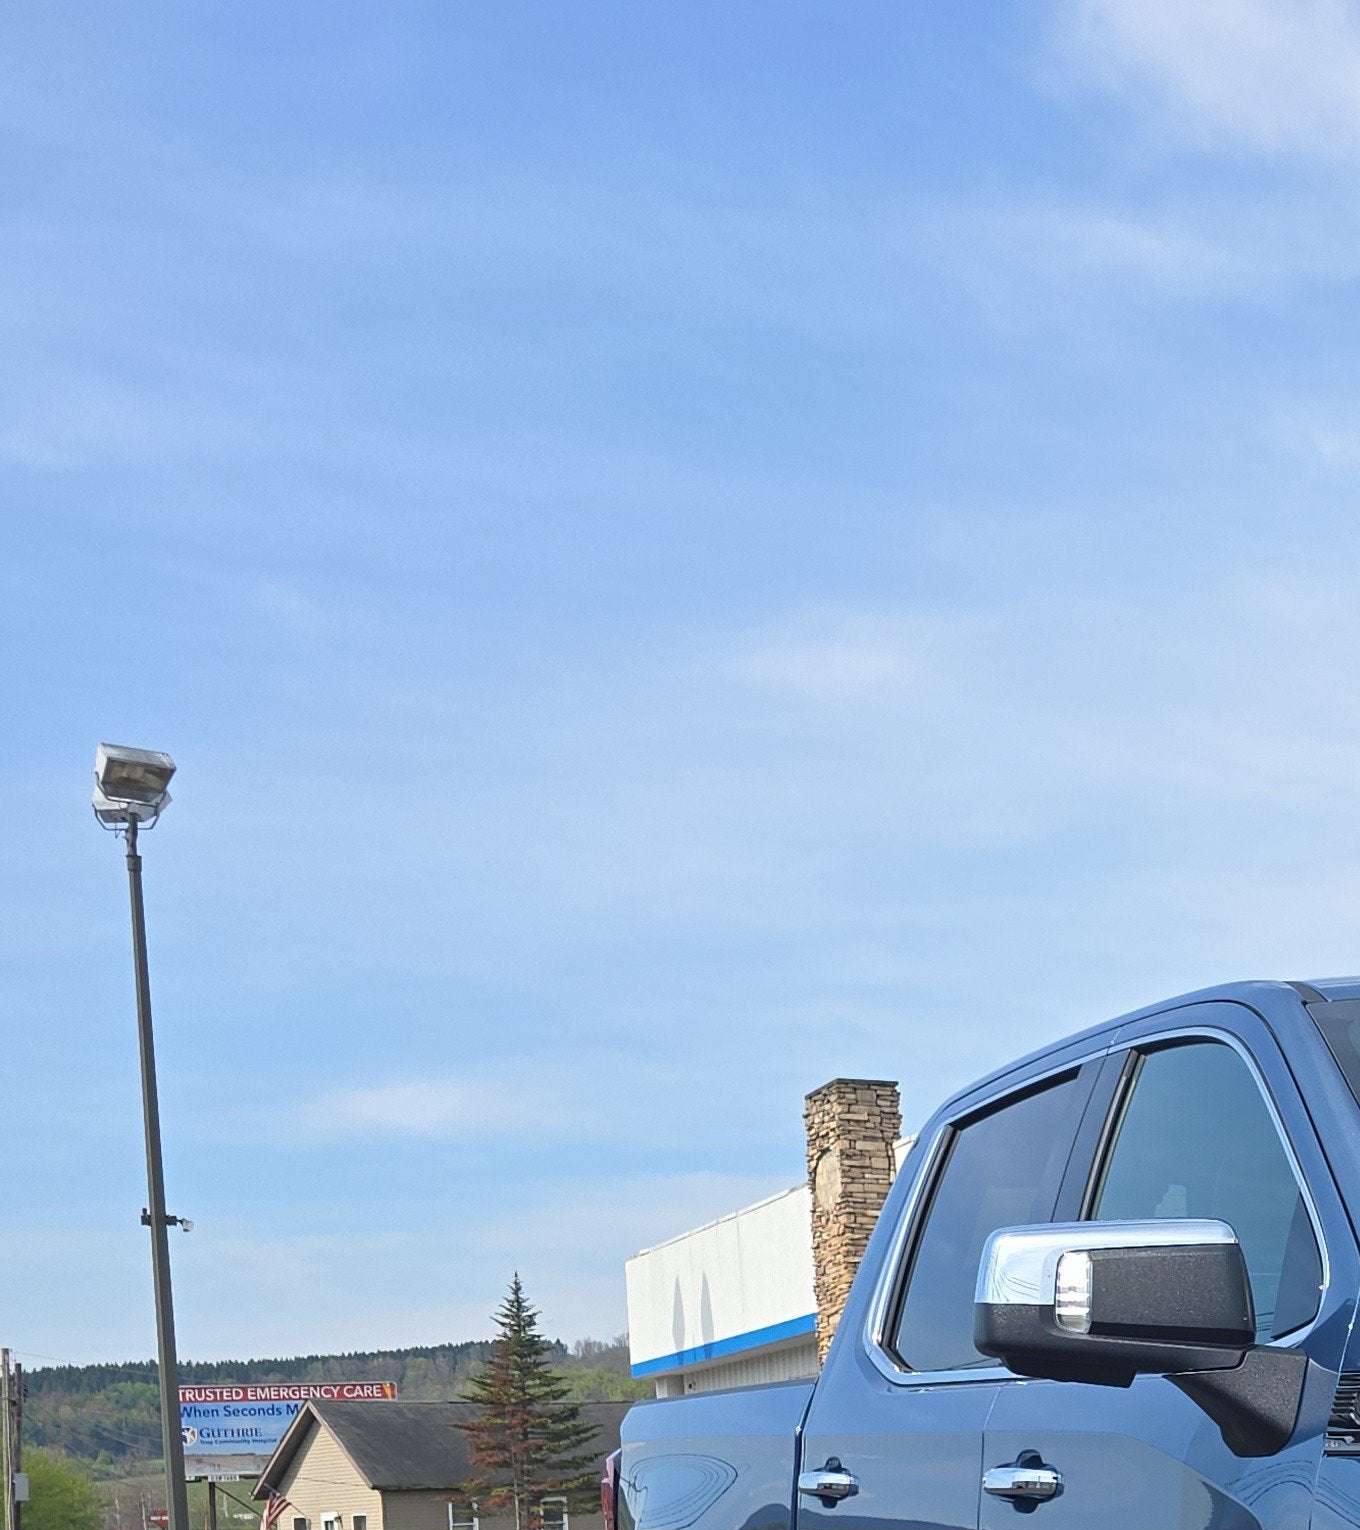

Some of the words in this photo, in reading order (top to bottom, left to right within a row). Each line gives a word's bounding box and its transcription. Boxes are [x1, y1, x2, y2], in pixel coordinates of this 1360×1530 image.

[179, 1388, 243, 1402] TRUSTED
[247, 1386, 340, 1400] EMERGENCY
[343, 1385, 382, 1398] CARE
[180, 1406, 219, 1418] When
[223, 1404, 283, 1417] Seconds
[286, 1404, 299, 1415] M
[199, 1427, 263, 1439] GUTHRIE
